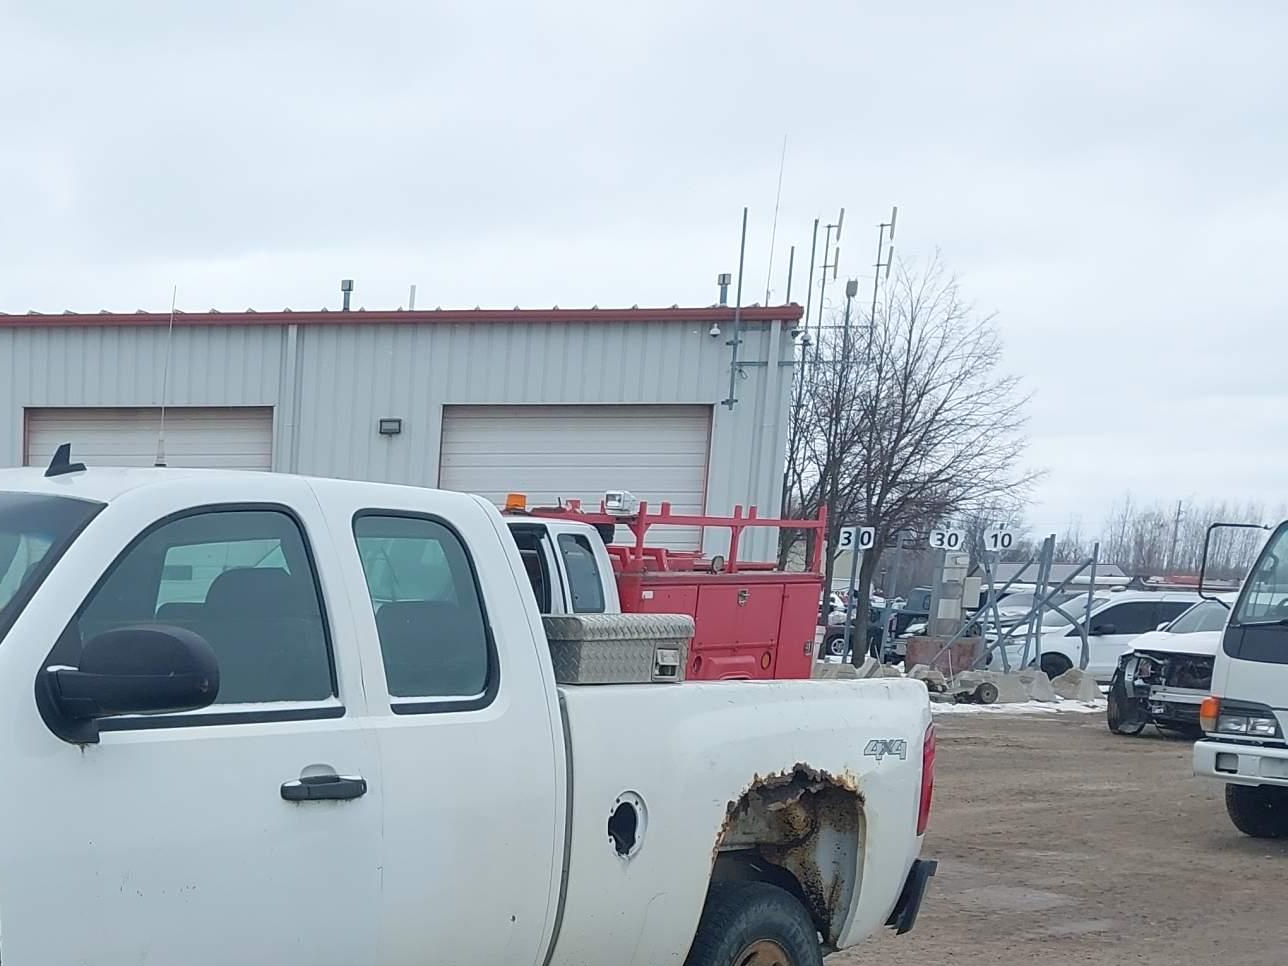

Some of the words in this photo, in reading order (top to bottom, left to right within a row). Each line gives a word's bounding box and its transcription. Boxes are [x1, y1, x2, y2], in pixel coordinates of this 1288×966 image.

[841, 531, 872, 546] 30
[934, 532, 959, 548] 30
[991, 533, 1012, 548] 10
